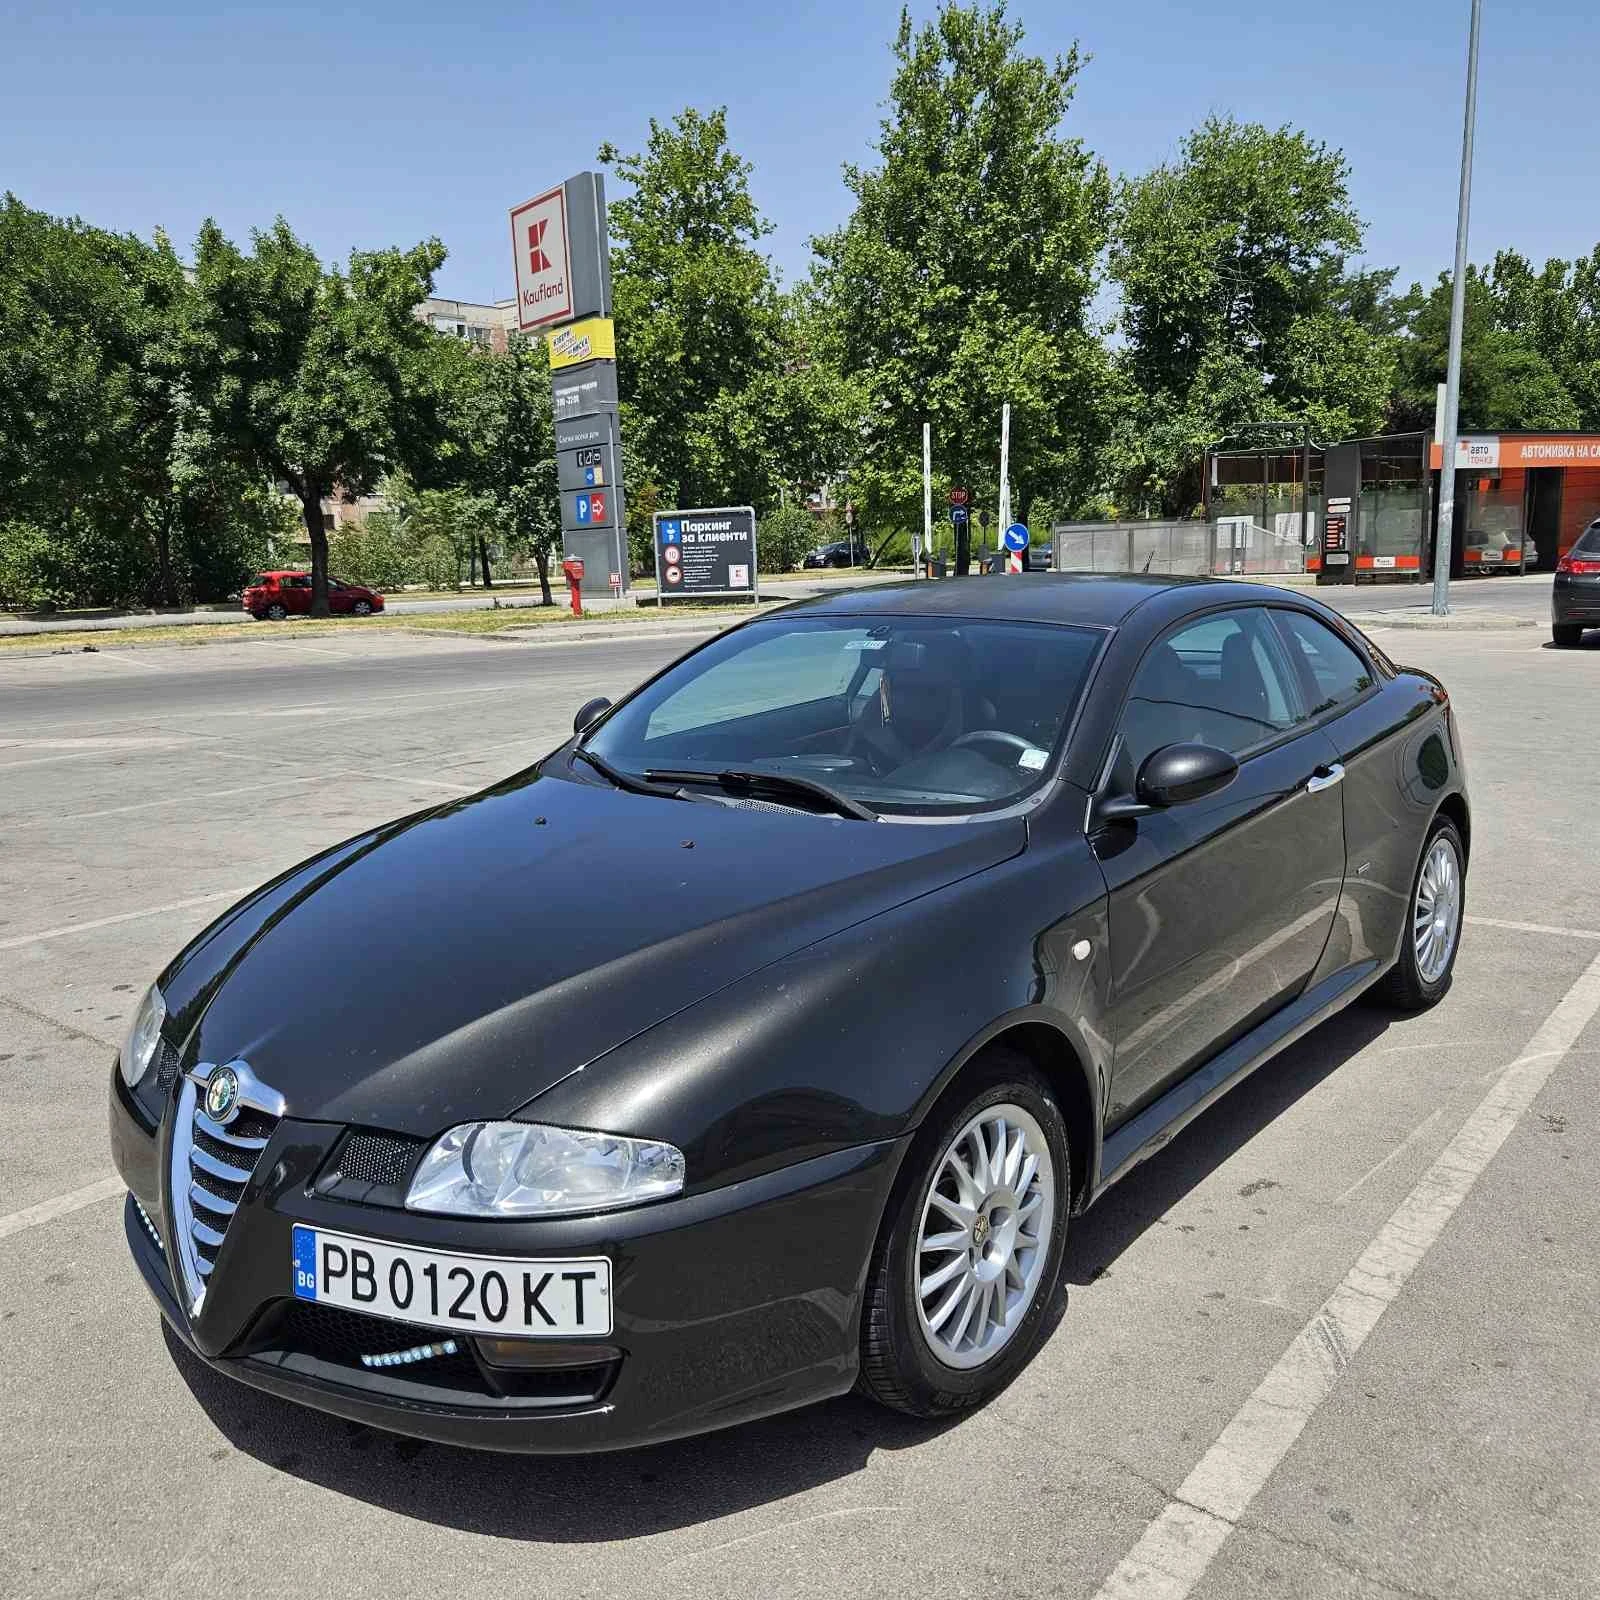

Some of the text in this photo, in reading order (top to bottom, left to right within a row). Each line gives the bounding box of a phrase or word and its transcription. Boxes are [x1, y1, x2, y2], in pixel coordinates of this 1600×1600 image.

[523, 277, 563, 306] Kaufland
[1520, 444, 1576, 459] АВТОМИВКА
[1577, 444, 1589, 457] НА
[951, 491, 966, 500] STOP
[680, 519, 732, 534] Паркинг
[681, 531, 748, 543] за клиенти
[297, 1270, 315, 1289] BG
[322, 1242, 597, 1327] PB 0120 KT
